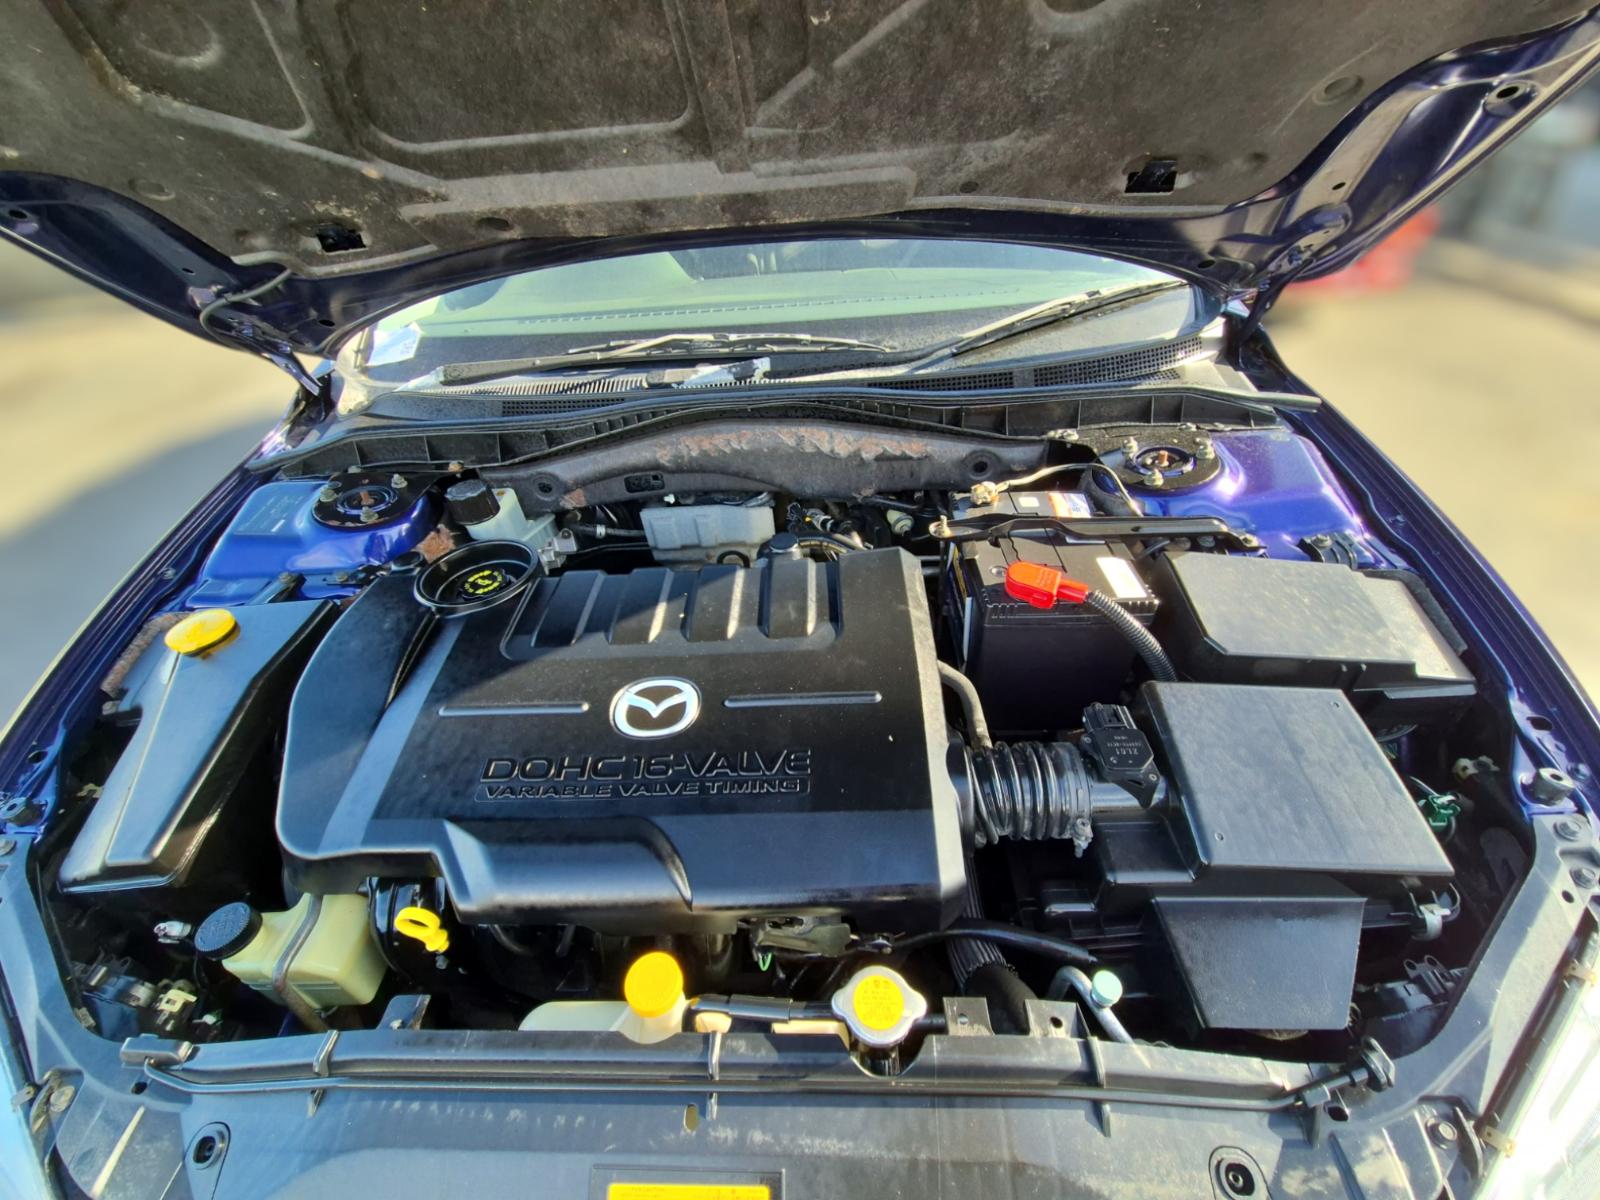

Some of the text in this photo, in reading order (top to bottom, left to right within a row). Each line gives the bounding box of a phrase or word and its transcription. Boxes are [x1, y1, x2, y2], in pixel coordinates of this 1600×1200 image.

[480, 749, 811, 782] DOHC 16-VALVE
[485, 779, 800, 798] VARIABLE VALVE TIMING
